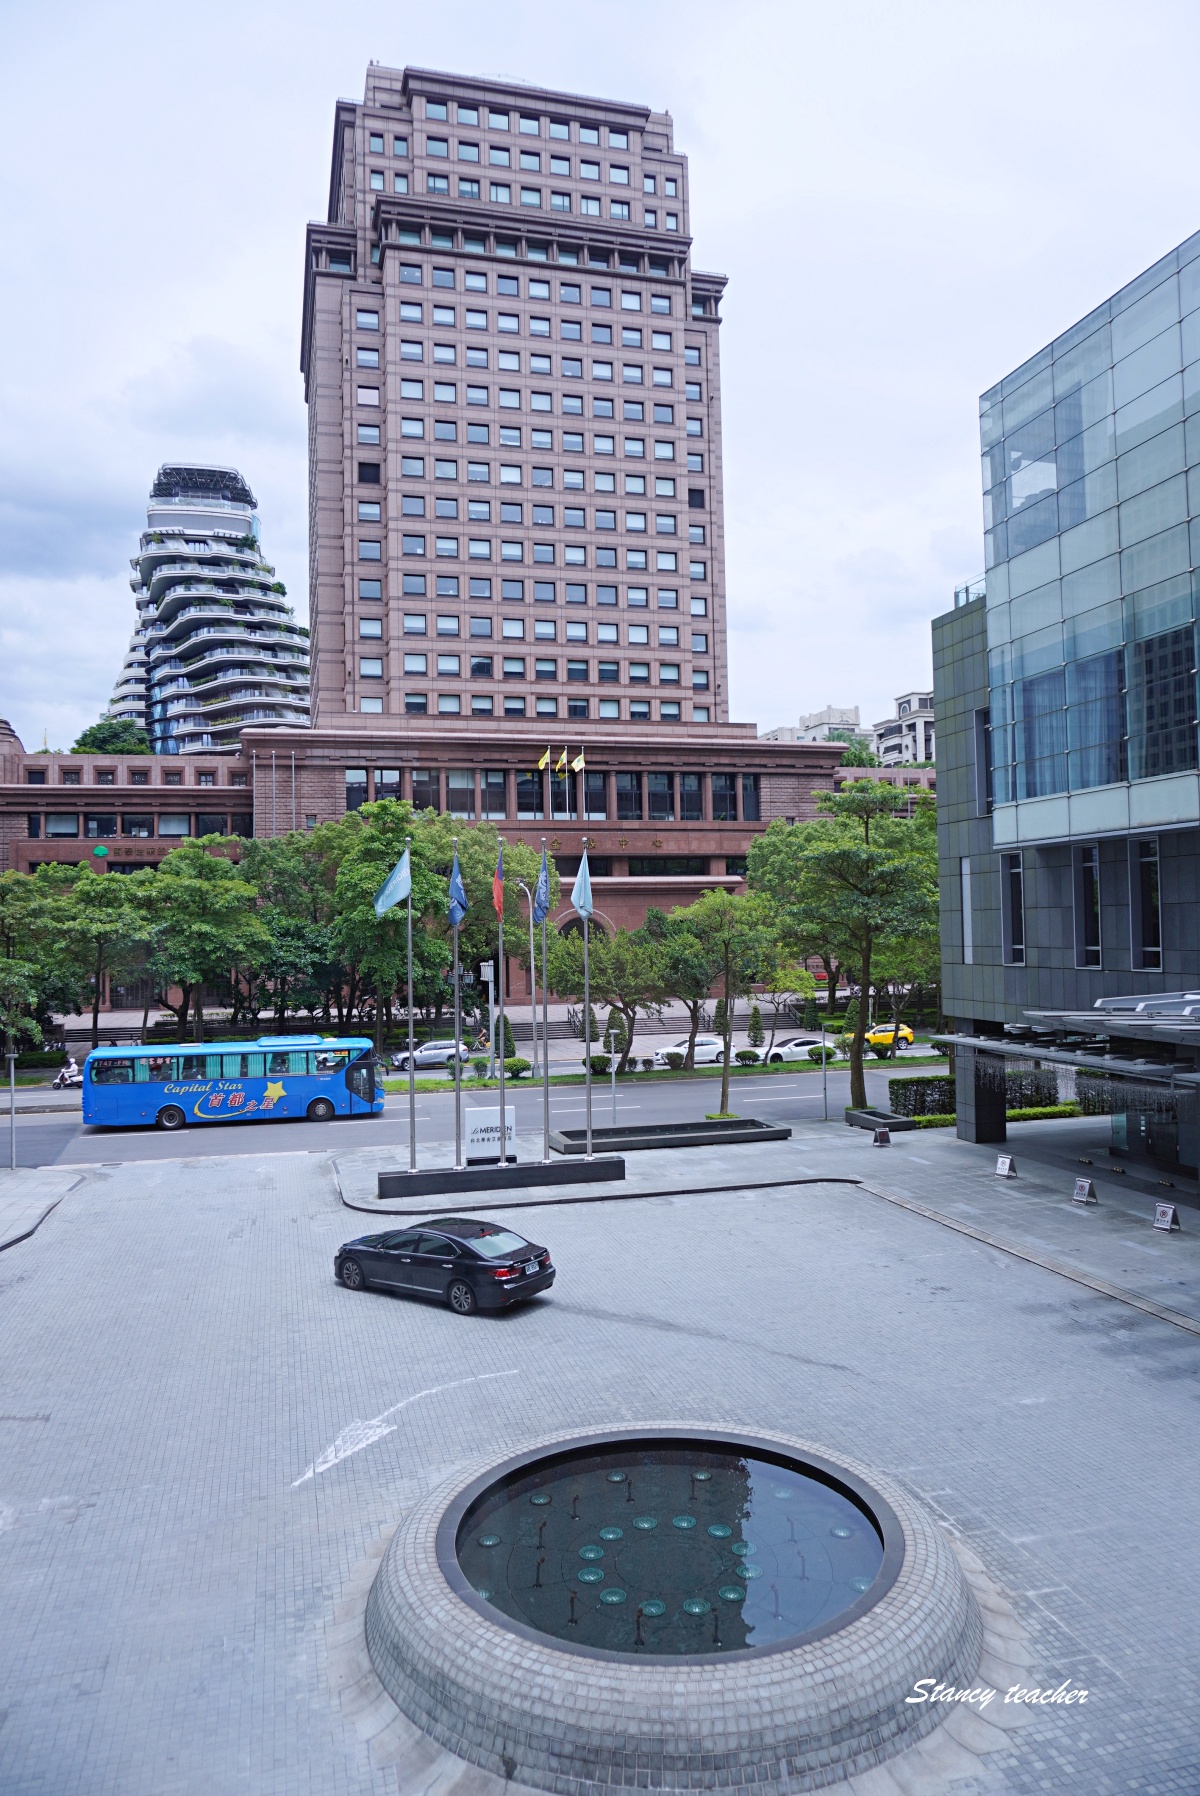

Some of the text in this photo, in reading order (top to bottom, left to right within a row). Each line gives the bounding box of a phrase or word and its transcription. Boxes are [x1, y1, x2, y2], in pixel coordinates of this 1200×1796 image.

[164, 1080, 243, 1096] Capital Star
[208, 1092, 275, 1112] 首都之星
